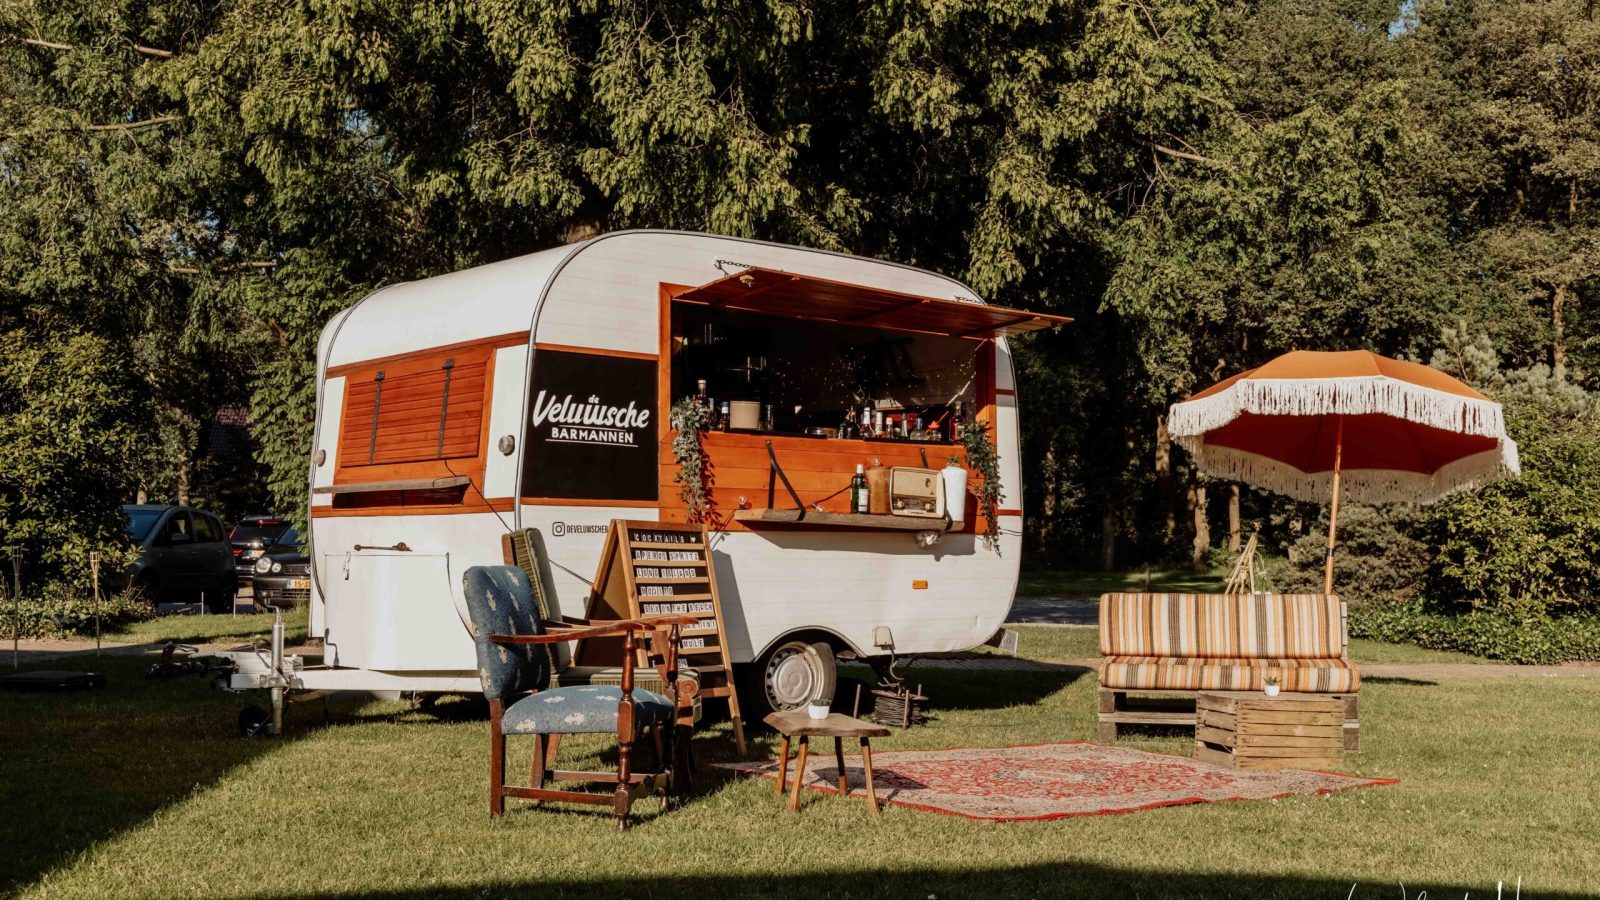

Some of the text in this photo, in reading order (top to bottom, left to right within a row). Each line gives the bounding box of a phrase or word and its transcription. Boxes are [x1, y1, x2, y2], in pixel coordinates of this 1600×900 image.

[588, 394, 599, 404] de
[533, 390, 650, 428] Veluwsche
[551, 428, 633, 443] BARMANNEN
[635, 533, 684, 543] COCKTAILS
[636, 551, 698, 560] APEROL SPRITZ
[637, 569, 695, 577] LONG ISLAND
[641, 587, 673, 595] MOJITO
[644, 603, 712, 613] SEX ON THE BEACH
[683, 639, 703, 647] MULE
